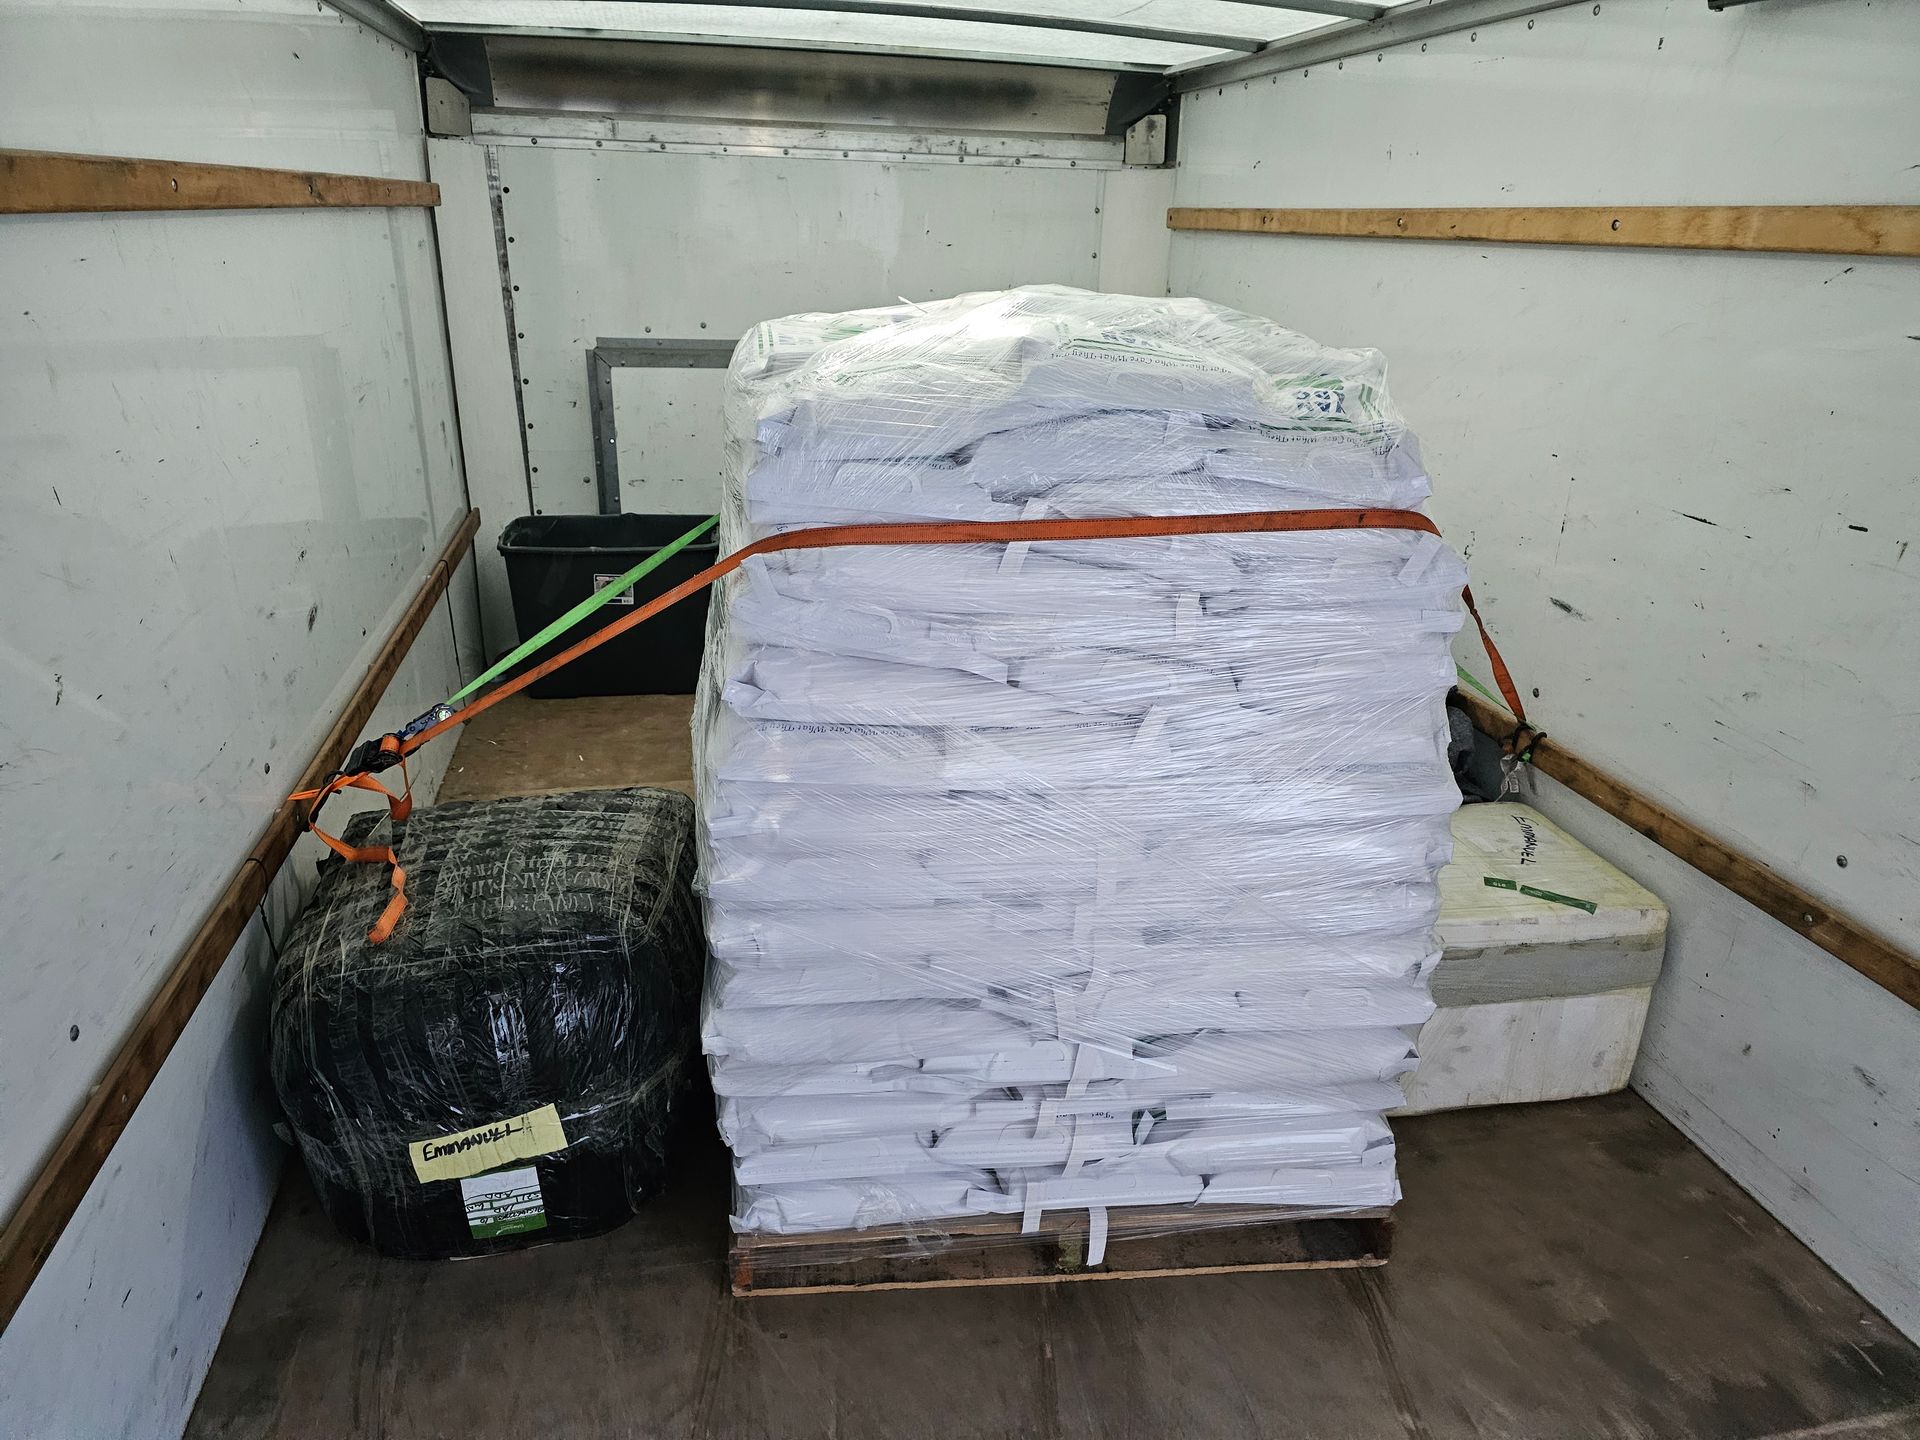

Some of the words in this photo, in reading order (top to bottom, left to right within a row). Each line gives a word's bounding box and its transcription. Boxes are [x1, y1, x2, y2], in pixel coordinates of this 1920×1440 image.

[1072, 349, 1097, 360] They
[1100, 353, 1128, 363] What
[1129, 355, 1152, 365] Care
[798, 724, 827, 734] What
[829, 725, 853, 735] Care
[854, 727, 879, 737] Who
